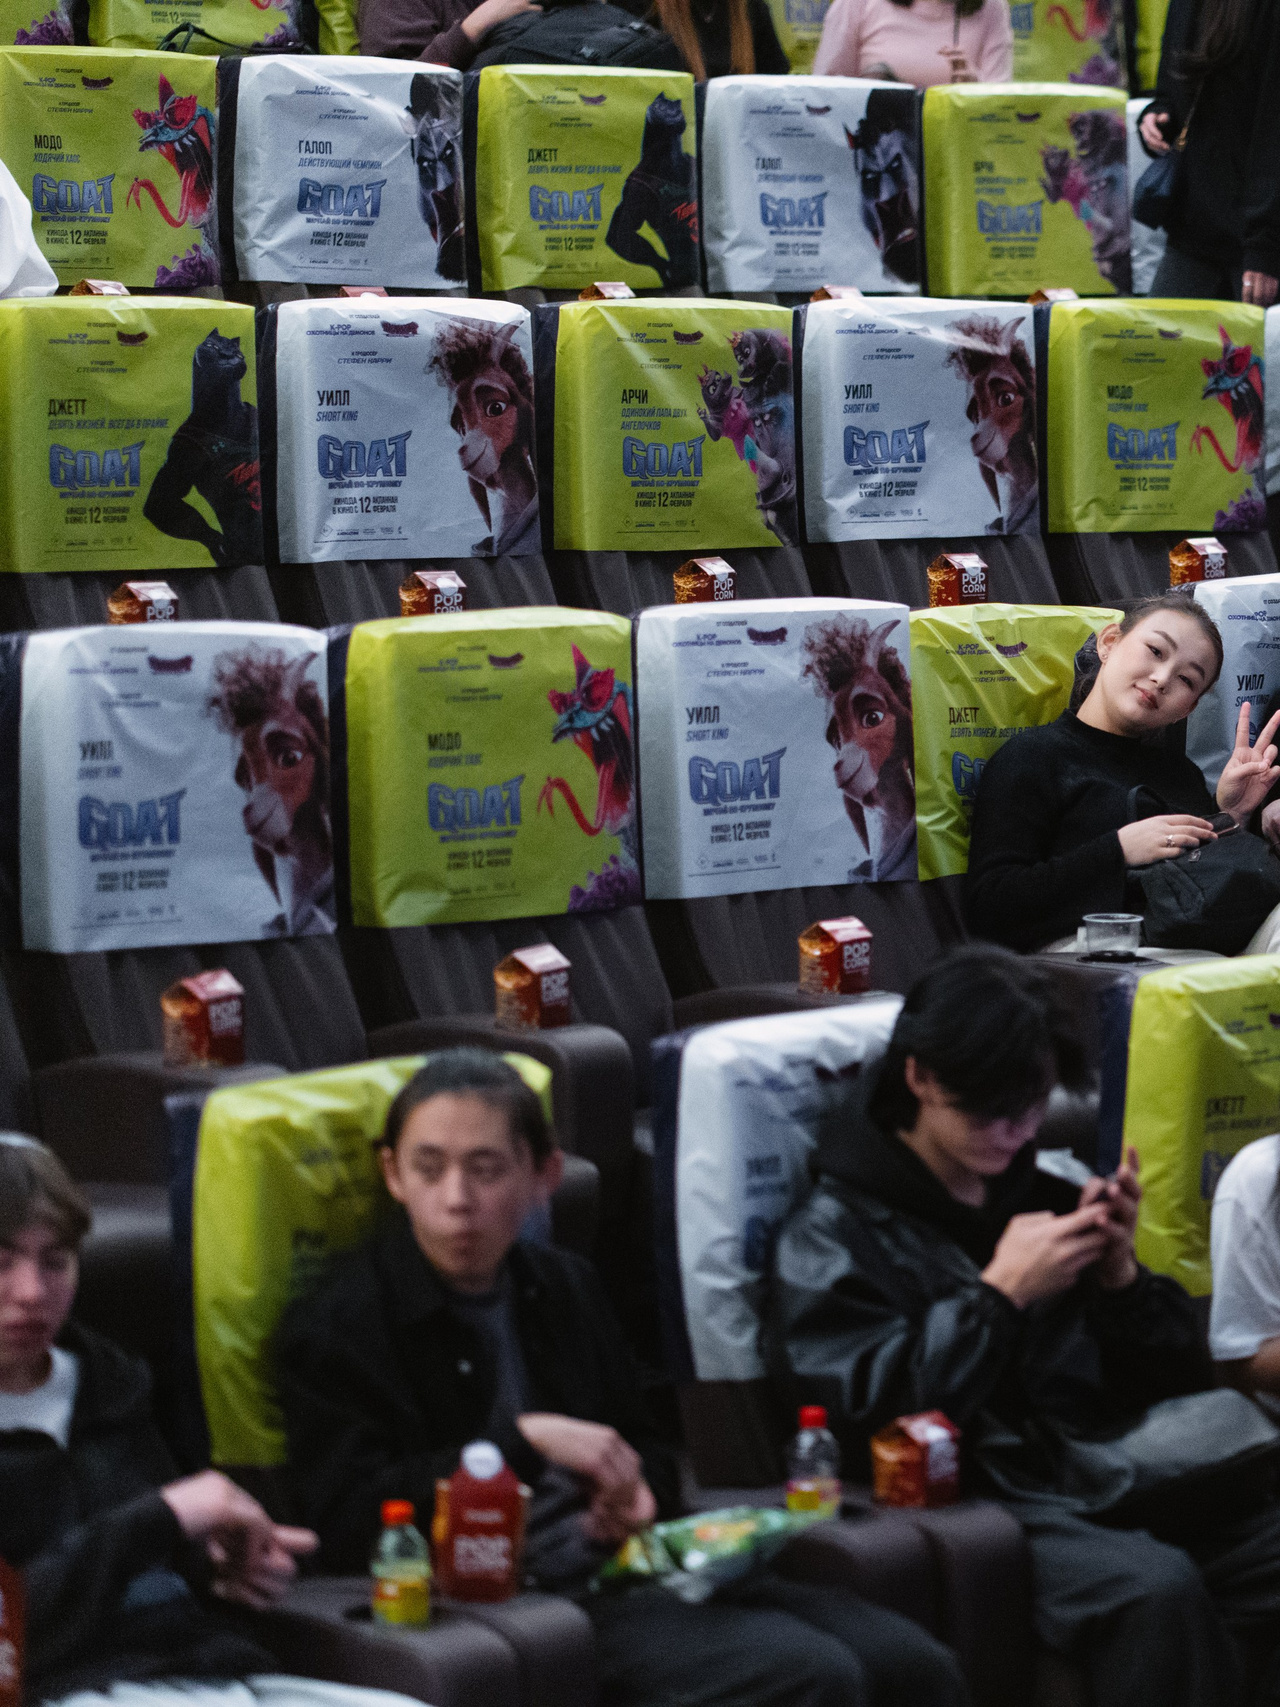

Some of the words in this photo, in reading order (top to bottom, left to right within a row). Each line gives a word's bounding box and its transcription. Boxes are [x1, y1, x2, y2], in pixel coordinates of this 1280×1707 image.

[34, 134, 62, 150] МОДО
[298, 140, 332, 155] ГАЛОП
[65, 154, 81, 164] ХАОС
[298, 157, 351, 169] ДЕЙСТВУЮЩИЙ
[527, 148, 558, 164] ДЖЕТТ
[32, 173, 115, 215] GOAT
[297, 177, 387, 218] GOAT
[529, 182, 605, 223] GOAT
[758, 190, 828, 229] GOAT
[70, 229, 82, 245] 12
[332, 232, 344, 247] 12
[317, 390, 350, 407] УИЛЛ
[621, 389, 648, 405] АРЧИ
[844, 384, 872, 400] УИЛЛ
[48, 398, 87, 417] ДЖЕТТ
[316, 411, 341, 422] SHORT
[342, 410, 358, 421] KING
[621, 408, 655, 418] ОДИНОКИЙ
[672, 408, 688, 418] ДВУХ
[843, 403, 865, 414] SHORT
[865, 402, 880, 413] KING
[620, 420, 661, 431] АНГЕЛОЧКОВ
[843, 420, 931, 467] GOAT
[1107, 420, 1180, 463] GOAT
[317, 430, 412, 481] GOAT
[623, 434, 706, 480] GOAT
[50, 440, 146, 490] GOAT
[882, 481, 893, 497] 12
[358, 496, 371, 514] 12
[657, 491, 668, 508] 12
[89, 506, 101, 523] 12
[337, 506, 353, 514] КИНО
[962, 572, 986, 585] POP
[1205, 569, 1225, 579] CORN
[714, 578, 734, 592] POP
[962, 584, 986, 594] CORN
[434, 593, 463, 606] POP
[714, 590, 734, 601] CORN
[1236, 674, 1265, 691] УИЛЛ
[686, 705, 720, 725] УИЛЛ
[949, 706, 980, 725] ДЖЕТТ
[428, 733, 461, 751] МОДО
[686, 728, 710, 742] SHORT
[711, 728, 729, 741] KING
[688, 746, 787, 806] GOAT
[427, 773, 526, 833] GOAT
[78, 788, 187, 851] GOAT
[732, 823, 745, 842] 12
[843, 942, 870, 959] POP
